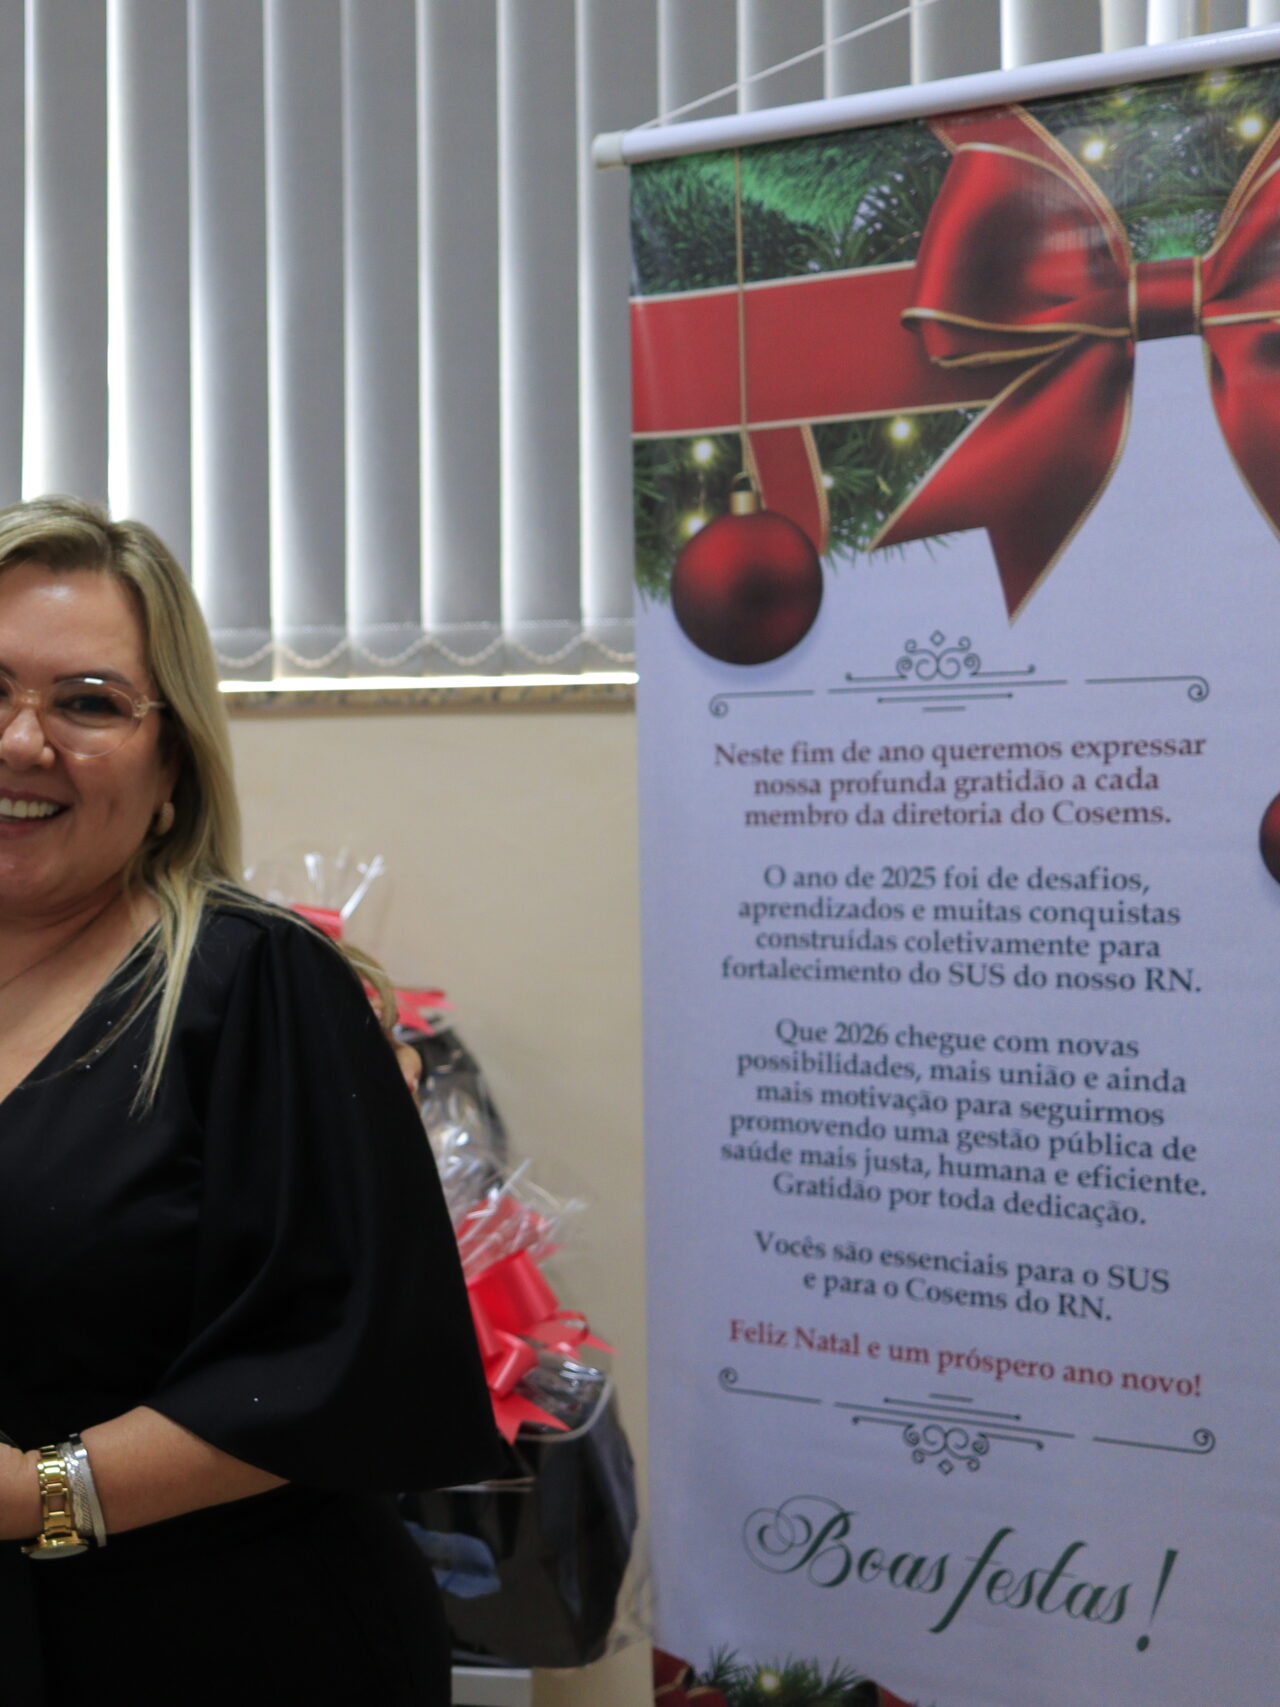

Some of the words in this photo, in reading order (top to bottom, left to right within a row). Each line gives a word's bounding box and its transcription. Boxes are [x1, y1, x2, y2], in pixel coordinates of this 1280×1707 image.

[715, 744, 784, 765] Neste
[792, 741, 834, 764] fim
[842, 740, 871, 763] de
[878, 745, 924, 762] ano
[932, 742, 1062, 768] queremos
[1071, 739, 1206, 765] expressar
[754, 779, 821, 795] nossa
[830, 770, 946, 802] profunda
[954, 768, 1064, 799] gratidão
[1072, 774, 1086, 791] a
[1095, 766, 1159, 791] cada
[745, 803, 848, 826] membro
[855, 803, 884, 826] da
[892, 802, 1002, 825] diretoria
[1010, 801, 1044, 825] do
[1052, 801, 1171, 824] Cosems.
[764, 867, 786, 886] O
[794, 872, 838, 888] ano
[845, 866, 874, 889] de
[882, 866, 936, 889] 2025
[944, 866, 978, 889] foi
[987, 866, 1018, 890] de
[1027, 866, 1149, 895] desafios,
[739, 896, 904, 924] aprendizados
[912, 905, 925, 921] e
[934, 902, 1021, 922] muitas
[1029, 904, 1181, 932] conquistas
[756, 928, 897, 951] construídas
[905, 929, 1089, 957] coletivamente
[1099, 940, 1160, 965] para
[722, 956, 901, 983] fortalecimento
[909, 961, 940, 984] do
[949, 963, 1005, 986] SUS
[1014, 964, 1047, 988] do
[1056, 973, 1136, 990] nosso
[1146, 967, 1201, 992] RN.
[776, 1020, 827, 1046] Que
[835, 1022, 889, 1045] 2026
[895, 1024, 986, 1055] chegue
[993, 1035, 1049, 1053] com
[1058, 1038, 1139, 1057] novas
[738, 1050, 921, 1082] possibilidades,
[930, 1060, 991, 1082] mais
[1000, 1063, 1076, 1088] união
[1084, 1072, 1098, 1089] e
[1107, 1067, 1186, 1093] ainda
[757, 1081, 813, 1103] mais
[821, 1086, 948, 1116] motivação
[956, 1098, 1012, 1121] para
[1020, 1098, 1165, 1127] seguirmos
[730, 1115, 886, 1139] promovendo
[894, 1126, 949, 1144] uma
[957, 1129, 1040, 1153] gestão
[1049, 1131, 1153, 1160] pública
[1162, 1136, 1197, 1162] de
[722, 1141, 792, 1163] saúde
[800, 1146, 856, 1168] mais
[865, 1148, 930, 1178] justa,
[939, 1153, 1046, 1184] humana
[1054, 1169, 1068, 1186] e
[1077, 1164, 1206, 1196] eficiente.
[773, 1173, 881, 1201] Gratidão
[889, 1188, 931, 1211] por
[939, 1188, 994, 1212] toda
[1003, 1191, 1145, 1227] dedicação.
[756, 1231, 826, 1258] Vocês
[834, 1245, 873, 1263] são
[880, 1251, 1008, 1277] essenciais
[1017, 1263, 1074, 1287] para
[1083, 1270, 1099, 1286] o
[1108, 1266, 1169, 1293] SUS
[803, 1274, 816, 1289] e
[824, 1276, 876, 1298] para
[884, 1281, 898, 1297] o
[906, 1278, 1007, 1309] Cosems
[1016, 1289, 1049, 1314] do
[1059, 1293, 1111, 1321] RN.
[730, 1320, 786, 1345] Feliz
[796, 1327, 859, 1356] Natal
[867, 1342, 880, 1358] e
[889, 1345, 930, 1364] um
[938, 1349, 1055, 1381] próspero
[1063, 1366, 1113, 1386] ano
[1122, 1373, 1200, 1397] novo!
[744, 1495, 949, 1593] Boas
